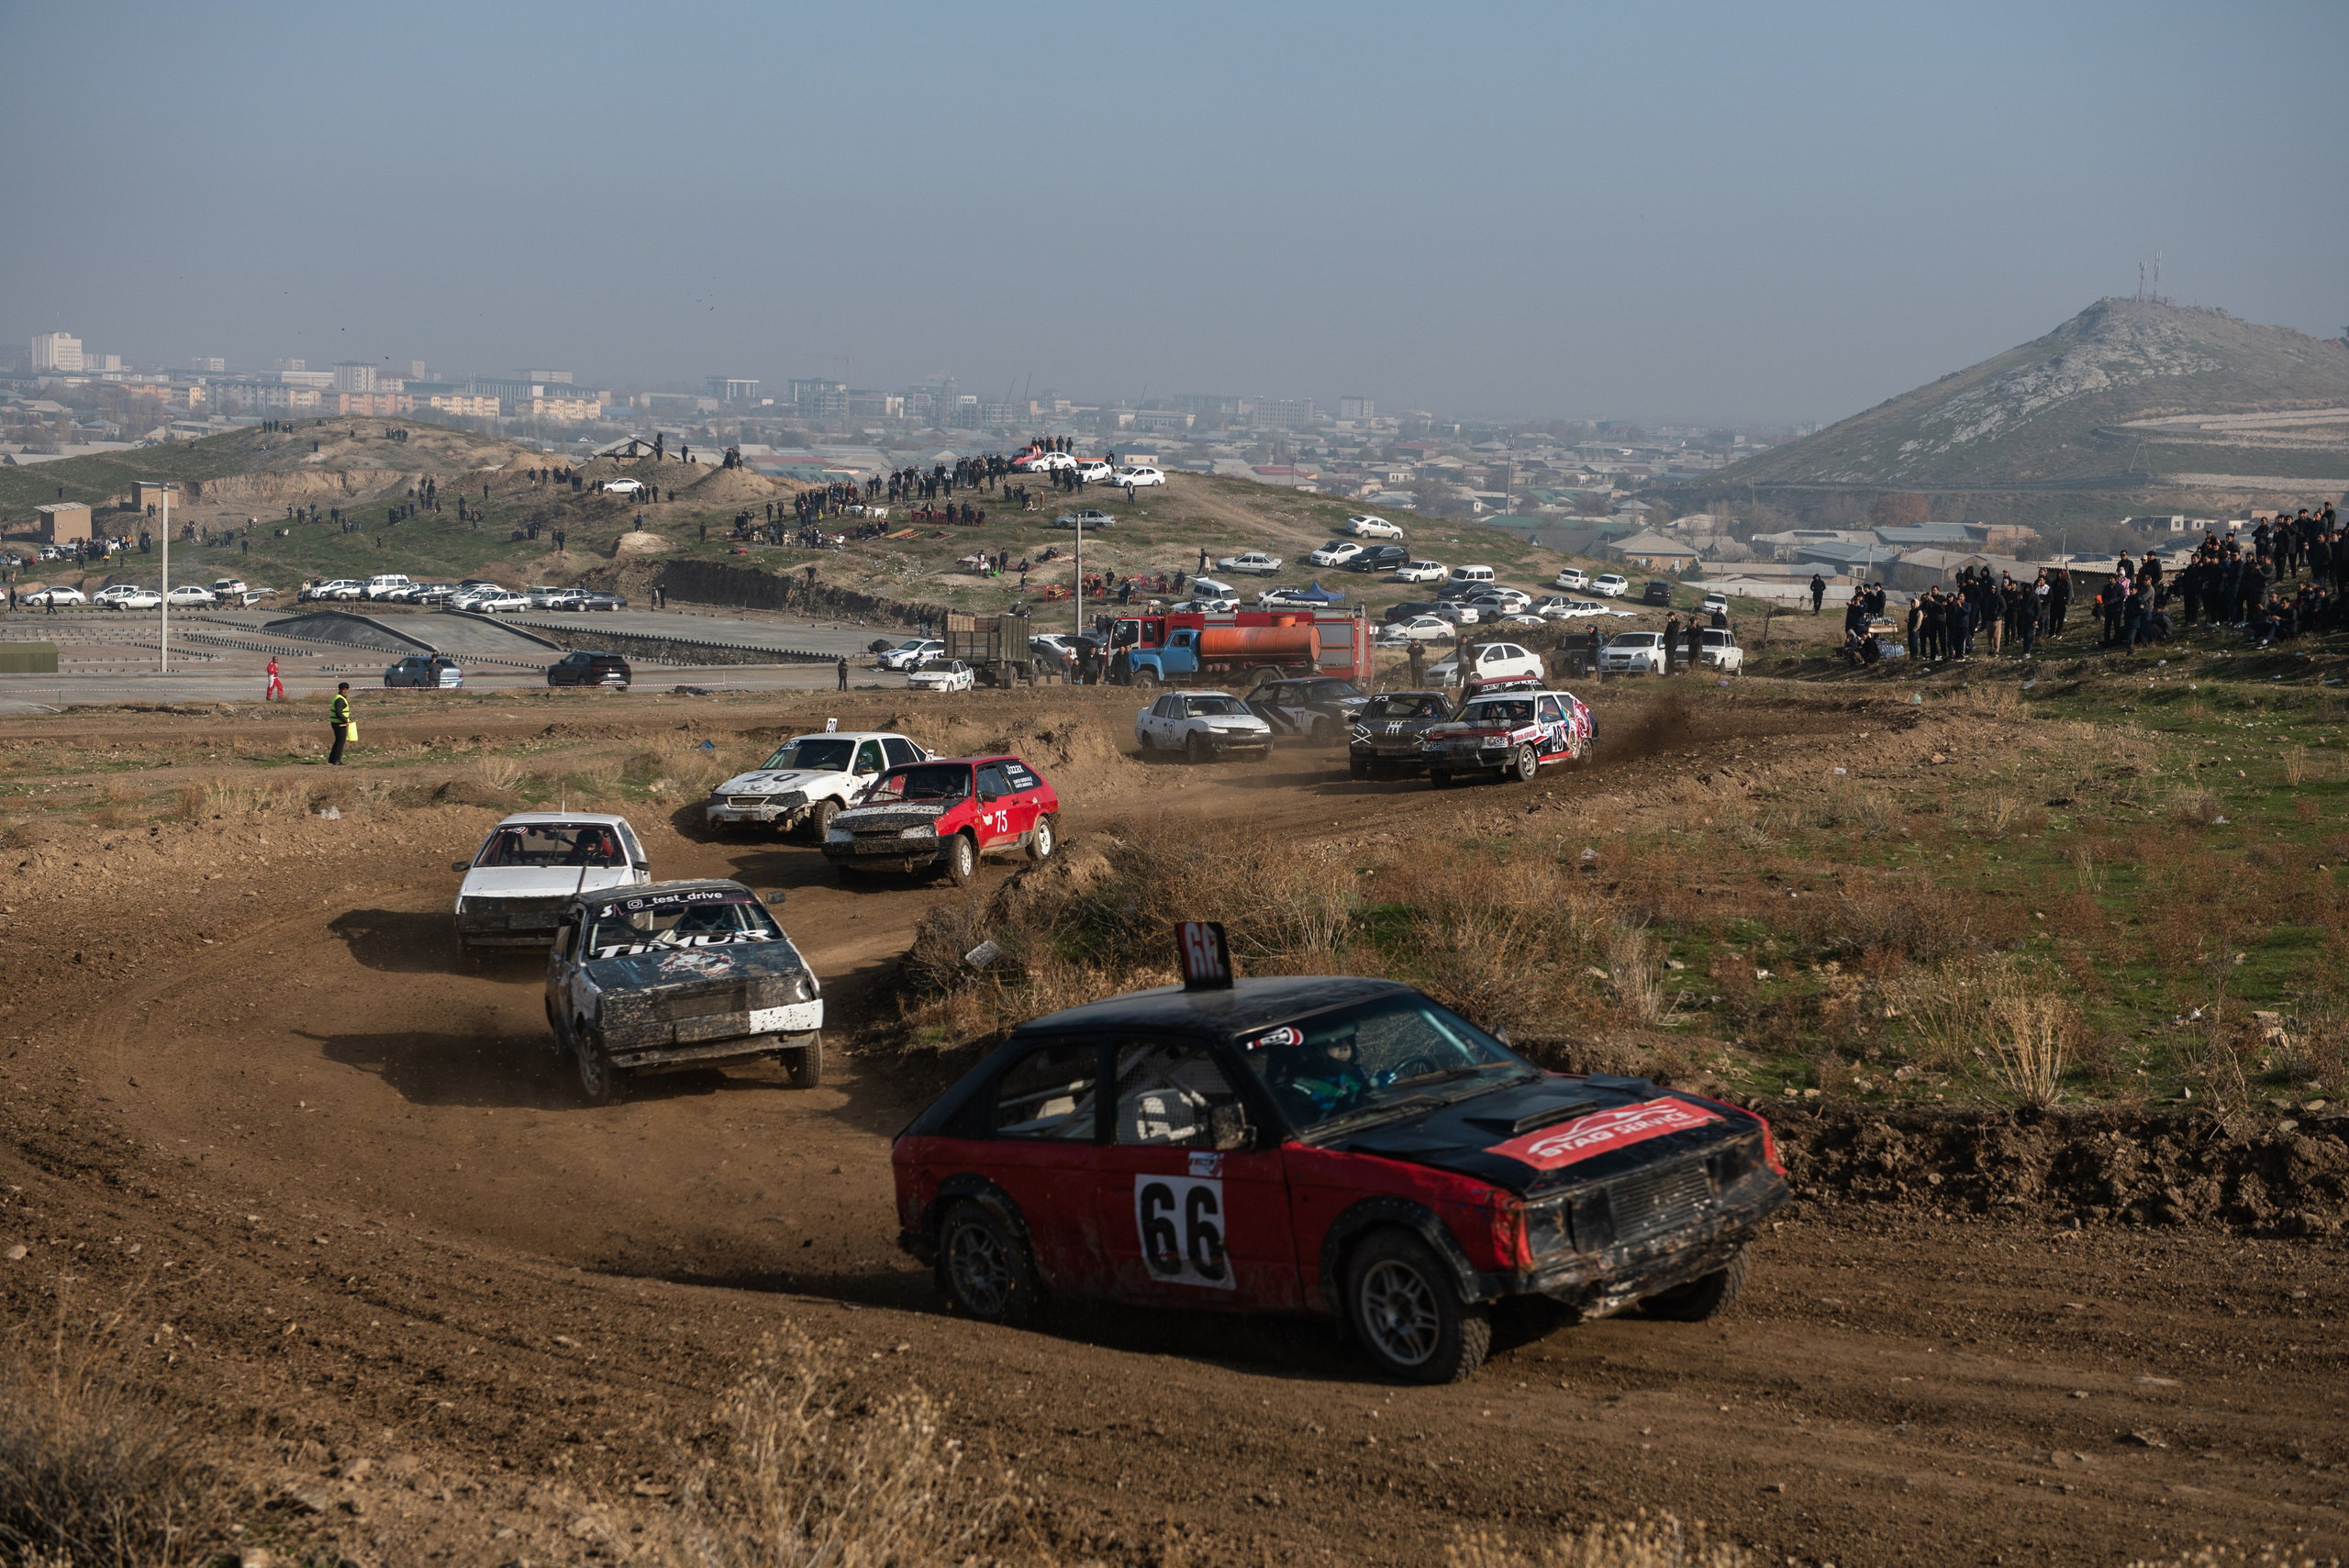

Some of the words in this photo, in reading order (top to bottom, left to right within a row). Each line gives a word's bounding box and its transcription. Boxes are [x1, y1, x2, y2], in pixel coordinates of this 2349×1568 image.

[827, 720, 836, 733] 20
[1294, 711, 1305, 723] 77
[1553, 725, 1563, 751] 48
[742, 773, 801, 783] 20
[996, 809, 1008, 832] 75
[645, 892, 723, 907] _test_drive
[1537, 1129, 1615, 1157] STAG
[1614, 1110, 1693, 1135] SERVICE
[1140, 1182, 1227, 1281] 66
